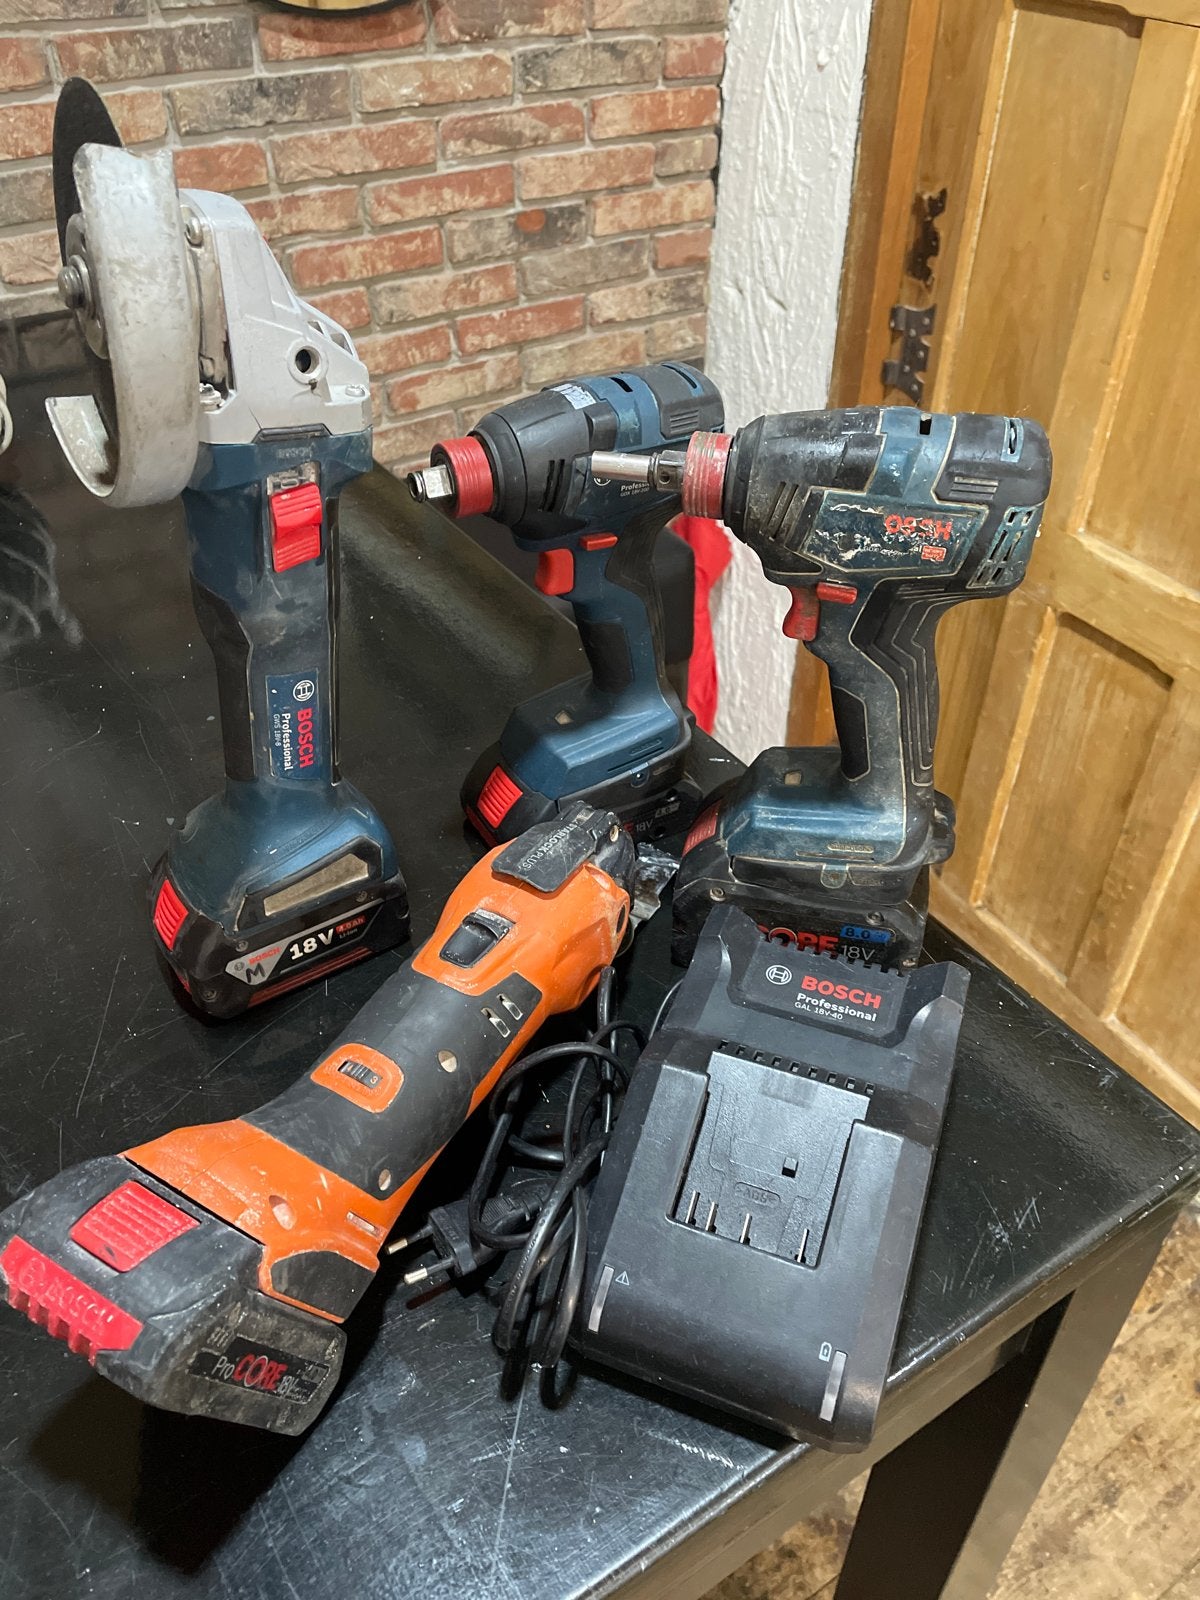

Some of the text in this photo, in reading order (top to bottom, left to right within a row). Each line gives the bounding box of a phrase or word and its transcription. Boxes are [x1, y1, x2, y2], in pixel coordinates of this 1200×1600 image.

[273, 713, 281, 729] GWS
[281, 712, 294, 771] Professional
[297, 707, 314, 768] BOSCH
[523, 851, 544, 871] PLUS
[845, 927, 871, 940] 8.0
[248, 947, 281, 964] BOSCH
[841, 944, 875, 961] 18V
[245, 962, 266, 983] M
[801, 975, 882, 1009] BOSCH
[794, 1001, 843, 1020] GAL 18V-40
[796, 993, 877, 1022] Professional
